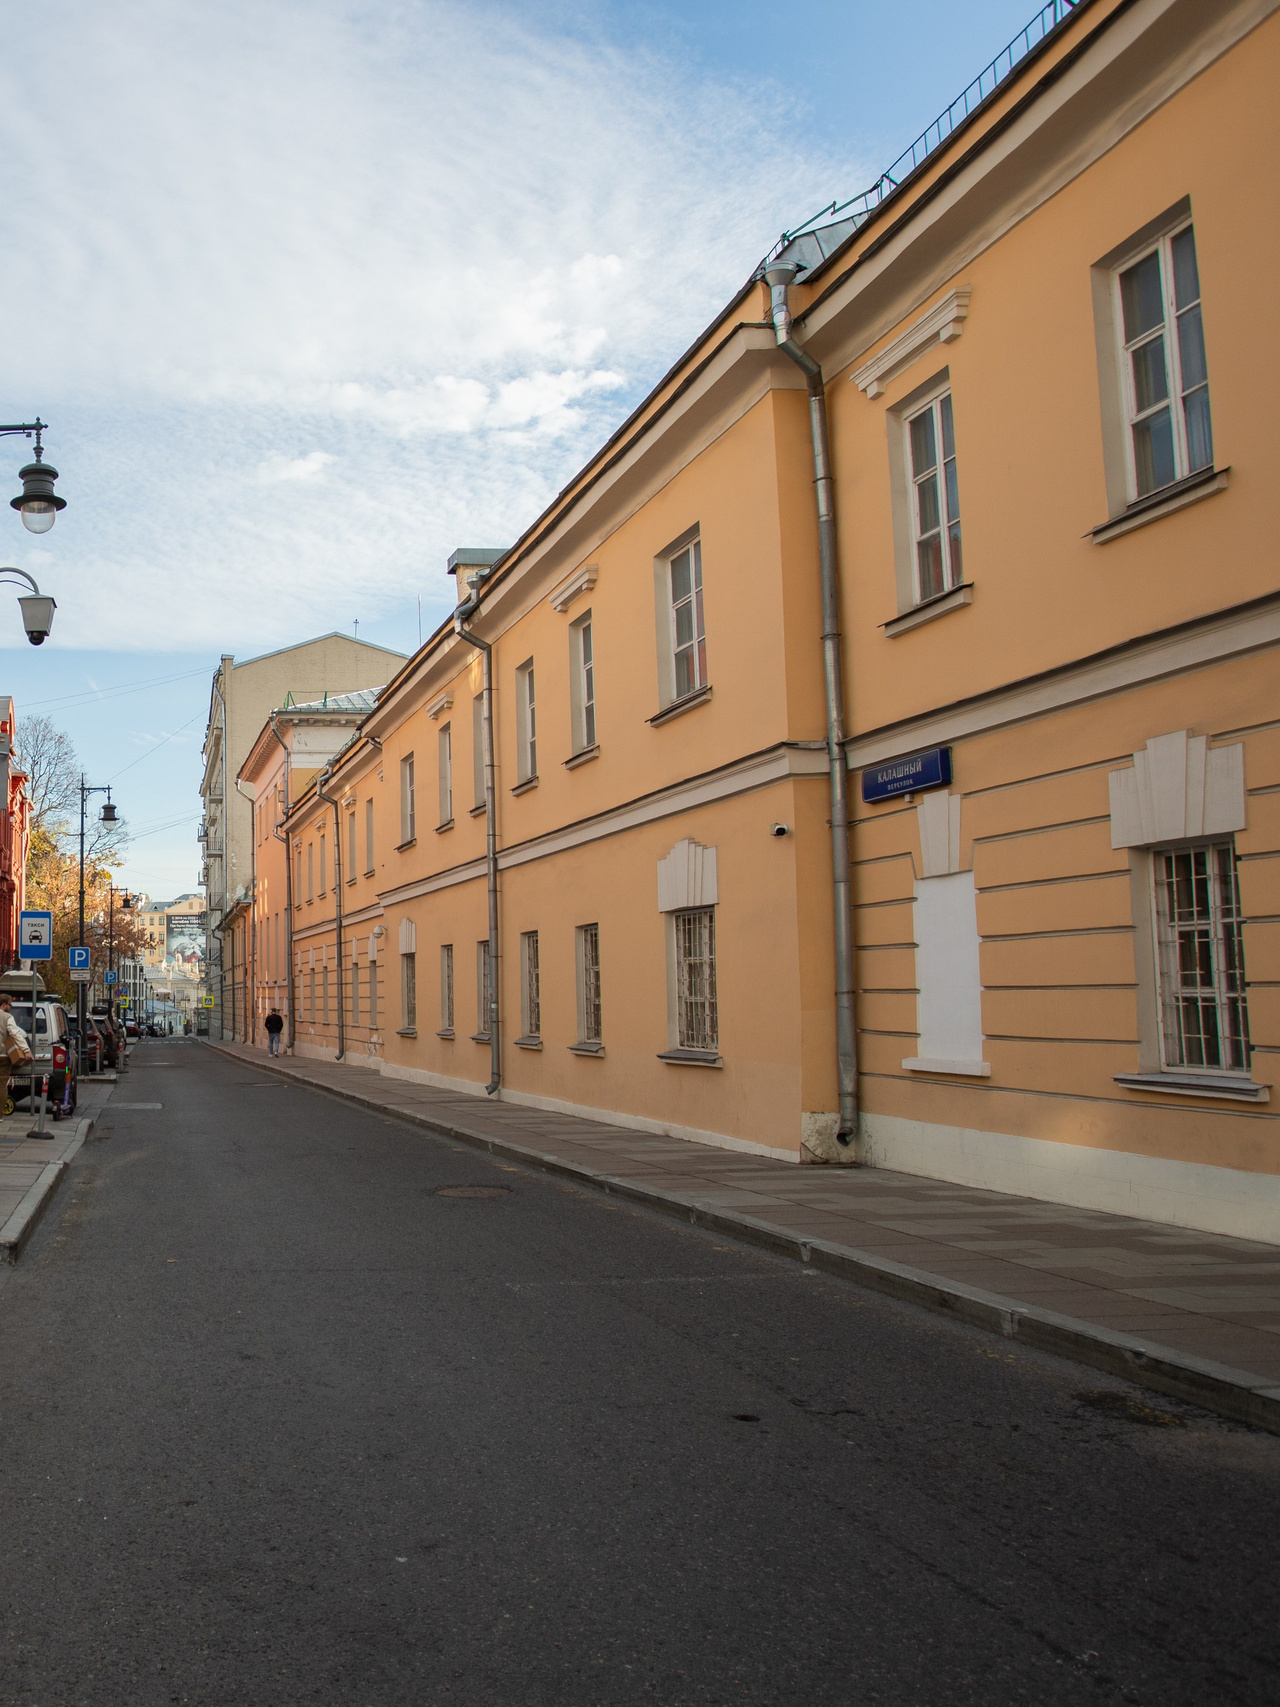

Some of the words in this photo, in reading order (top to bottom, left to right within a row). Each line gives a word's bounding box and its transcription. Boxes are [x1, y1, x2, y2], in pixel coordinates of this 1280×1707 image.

[877, 759, 922, 784] КАЛАШНЫЙ
[887, 778, 914, 791] ПЕРЕУЛОК
[75, 950, 86, 966] P
[108, 973, 114, 982] P
